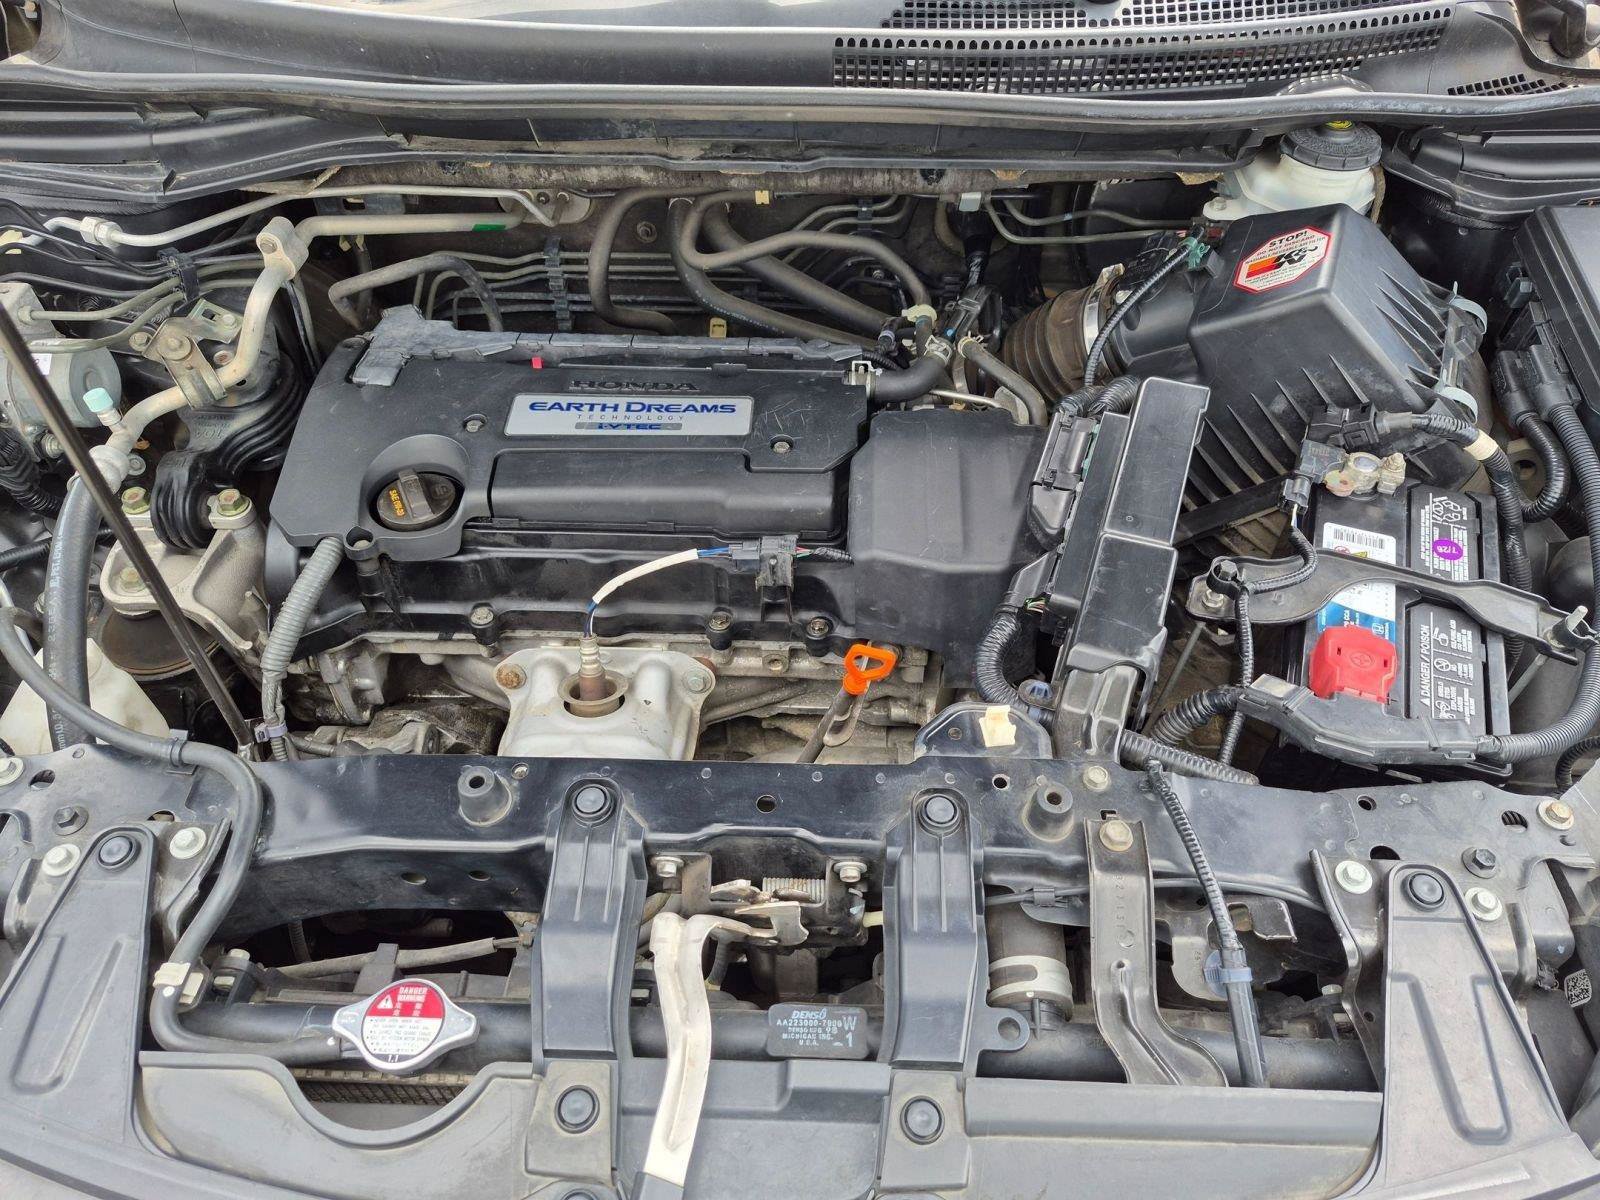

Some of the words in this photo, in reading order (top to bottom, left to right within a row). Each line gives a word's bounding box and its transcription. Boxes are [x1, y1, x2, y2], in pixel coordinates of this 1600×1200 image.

[1268, 245, 1282, 253] NOT
[1284, 235, 1316, 248] DISCARD
[1269, 231, 1308, 248] STOP!
[569, 380, 700, 392] HONDA
[529, 402, 620, 413] EARTH
[625, 401, 737, 413] DREAMS
[1420, 625, 1431, 654] POISON
[1420, 662, 1431, 697] DANGER
[792, 1008, 827, 1019] DENSO
[842, 1015, 857, 1030] W
